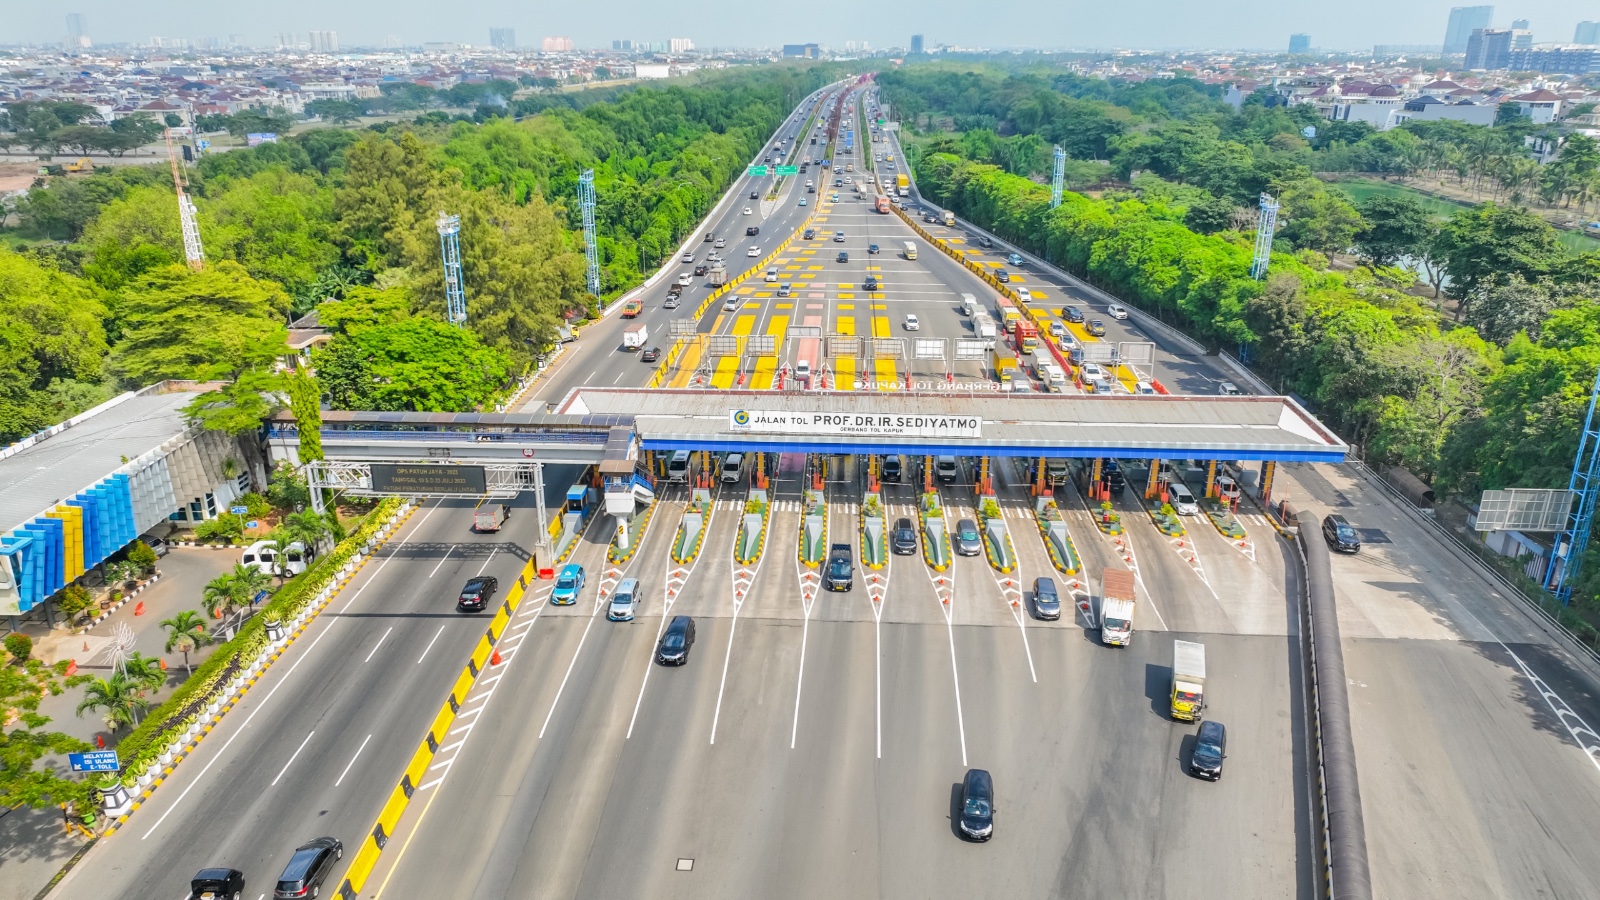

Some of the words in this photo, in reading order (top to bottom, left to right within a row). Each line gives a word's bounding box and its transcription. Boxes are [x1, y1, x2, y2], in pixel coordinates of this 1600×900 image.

[754, 416, 786, 424] JALAN
[791, 417, 808, 425] TOL
[896, 417, 977, 429] SEDIYATMO
